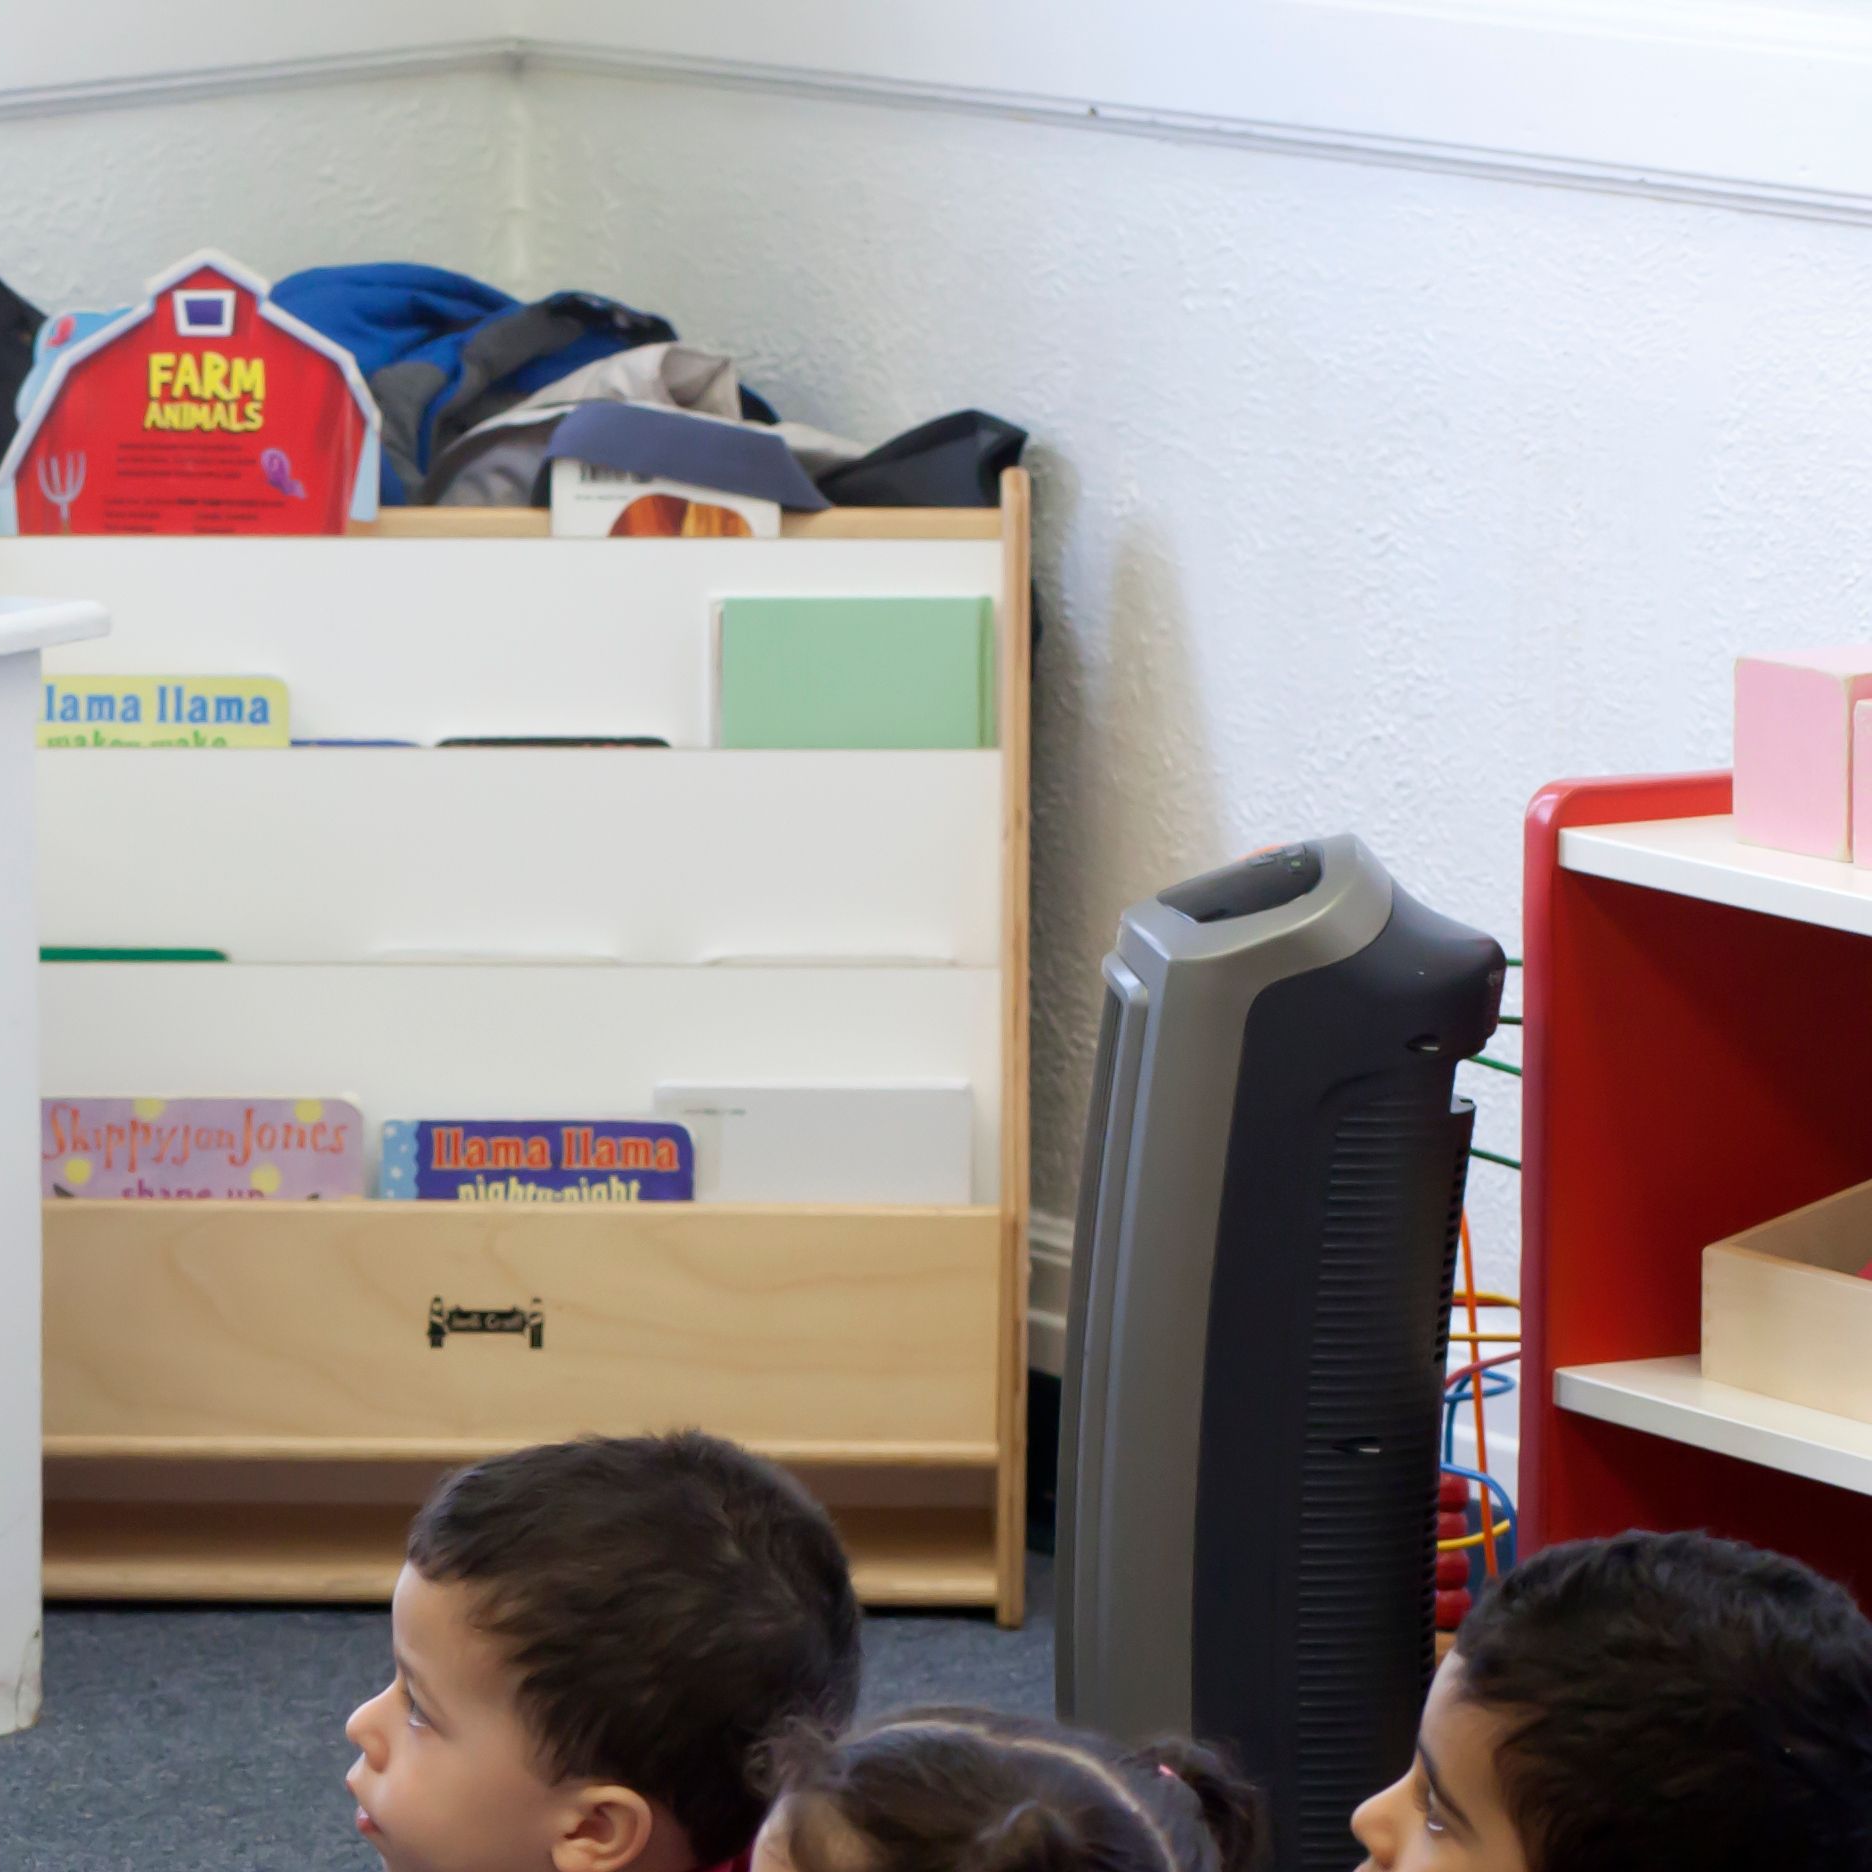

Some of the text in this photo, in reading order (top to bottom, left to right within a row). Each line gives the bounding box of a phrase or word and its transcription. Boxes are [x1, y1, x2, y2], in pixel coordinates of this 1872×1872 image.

[147, 351, 266, 401] FARM
[143, 400, 265, 432] ANIMALS
[44, 684, 270, 724] lama llama
[431, 1126, 680, 1172] llama llama
